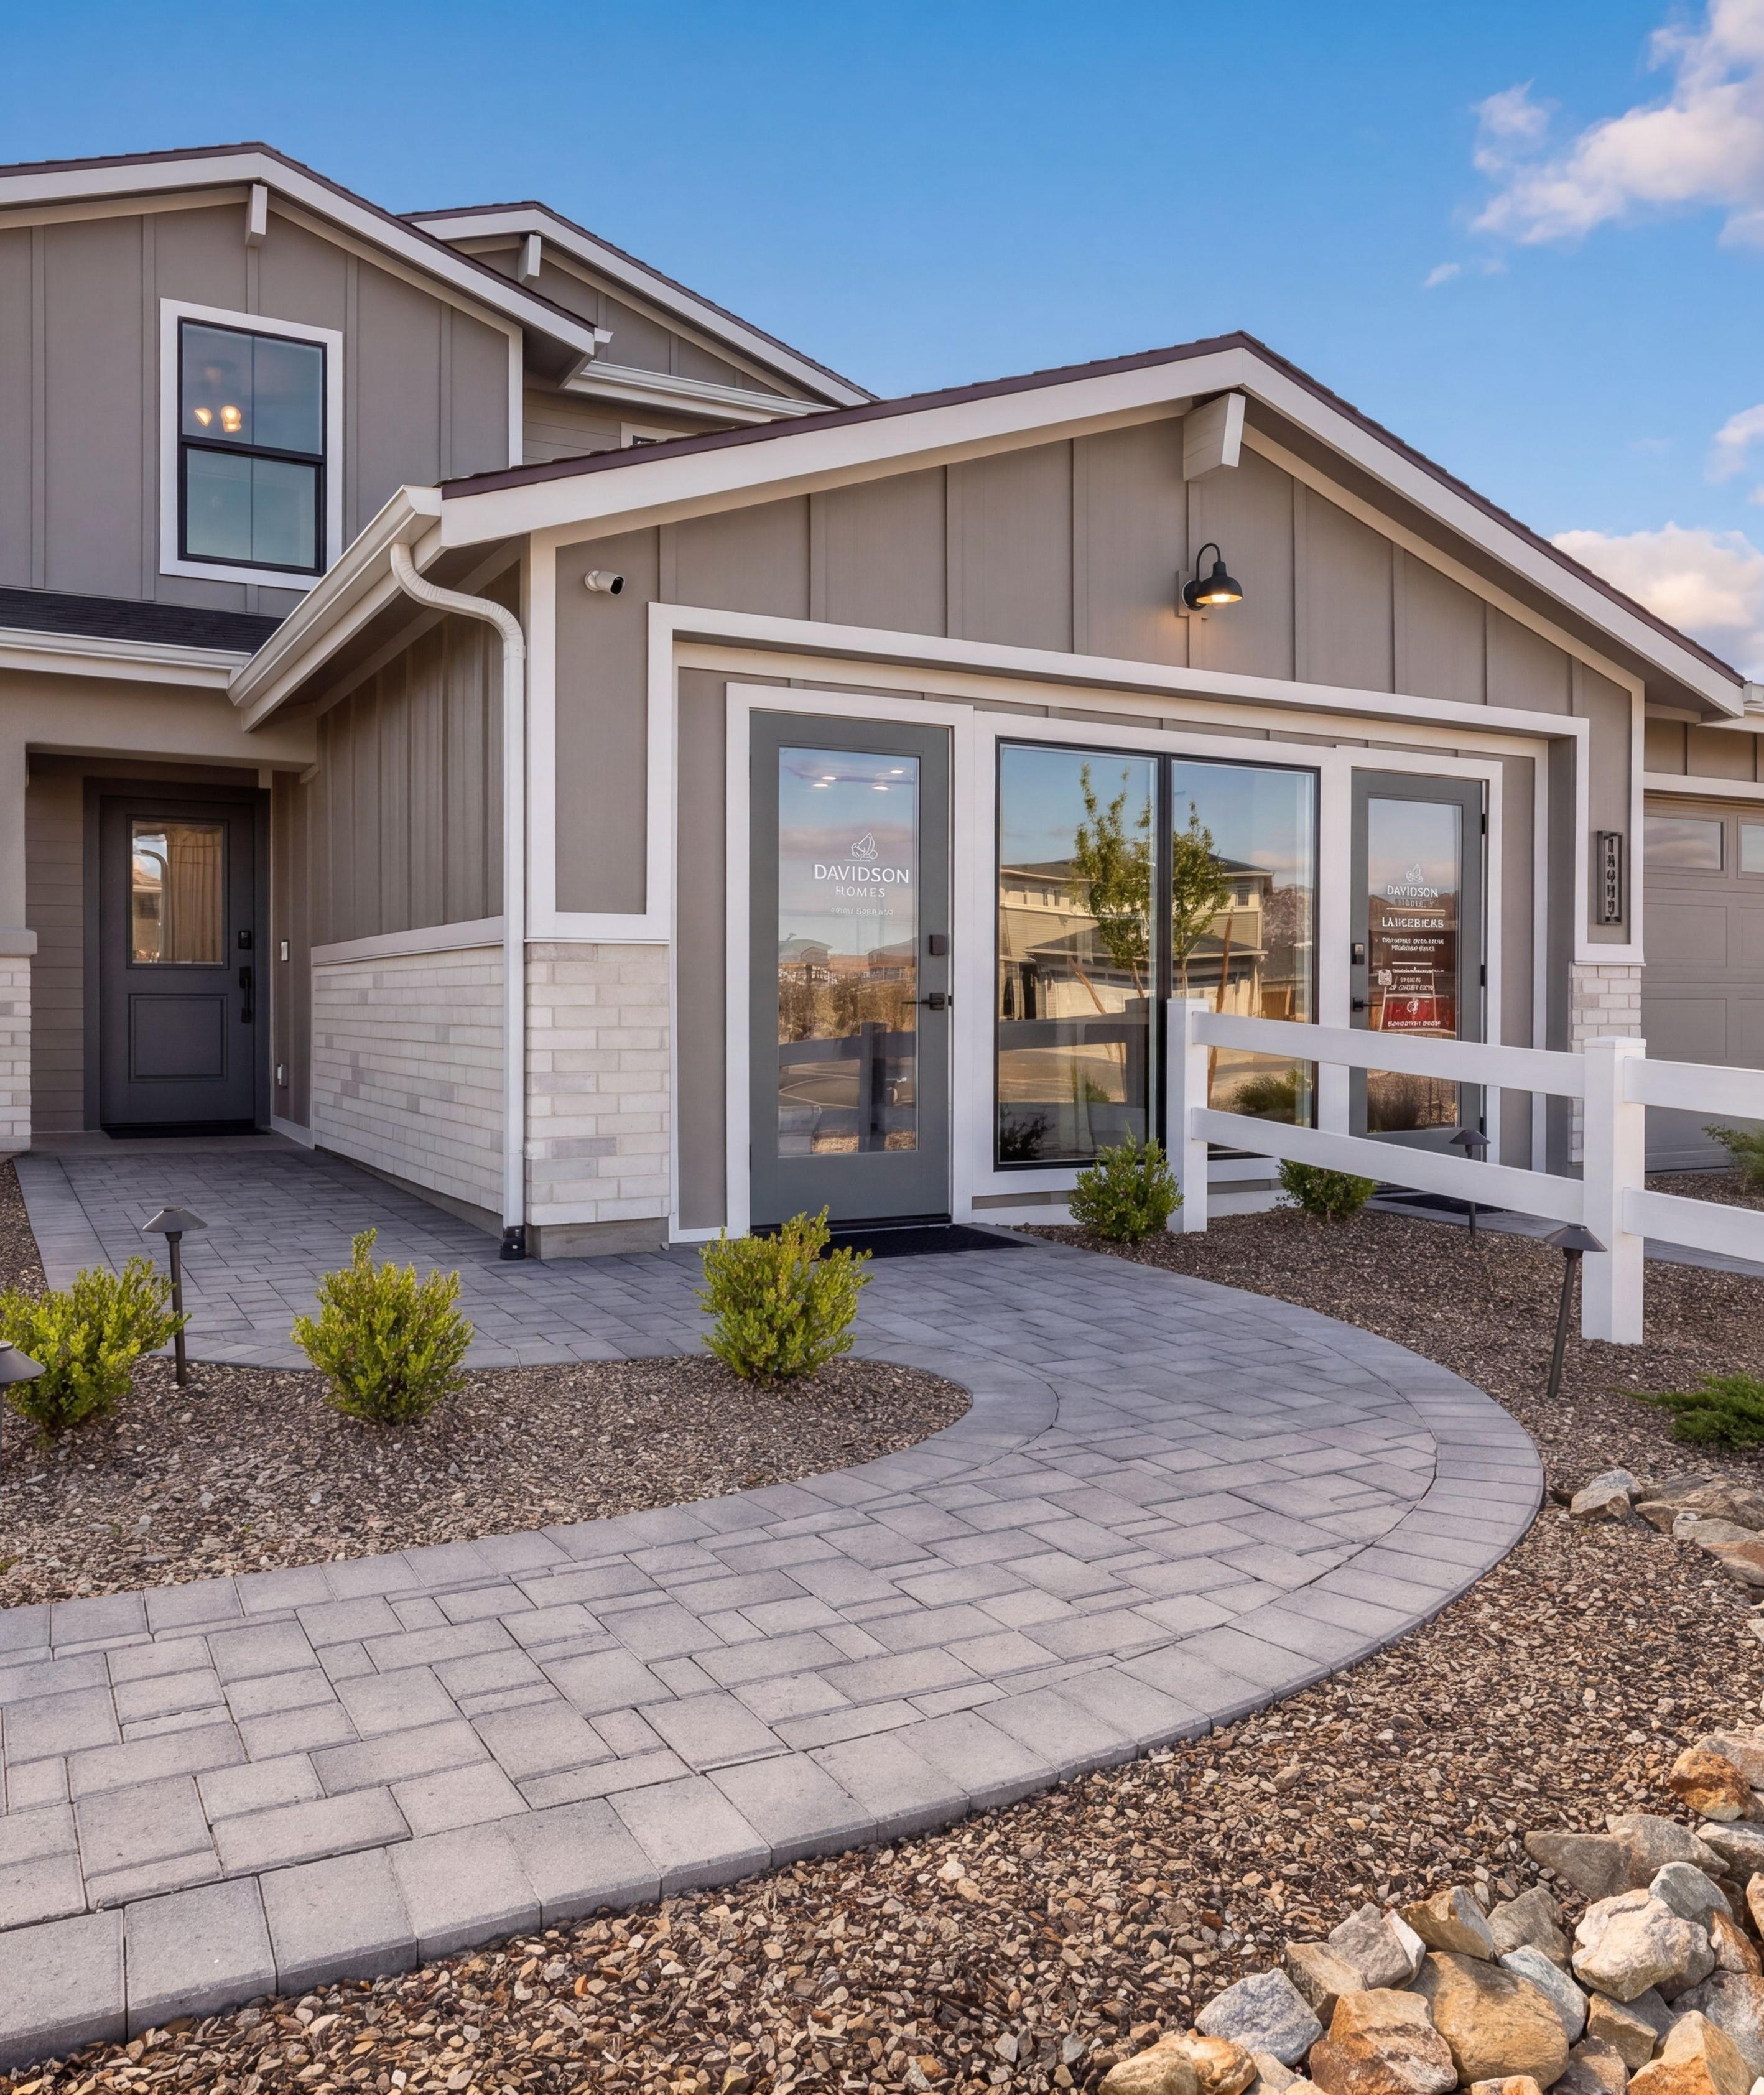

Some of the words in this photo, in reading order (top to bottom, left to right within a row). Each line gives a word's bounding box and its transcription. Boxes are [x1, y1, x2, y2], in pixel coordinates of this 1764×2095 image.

[814, 864, 909, 883] DAVIDSON
[835, 886, 885, 898] HOMES
[1387, 885, 1439, 898] DAVIDSON
